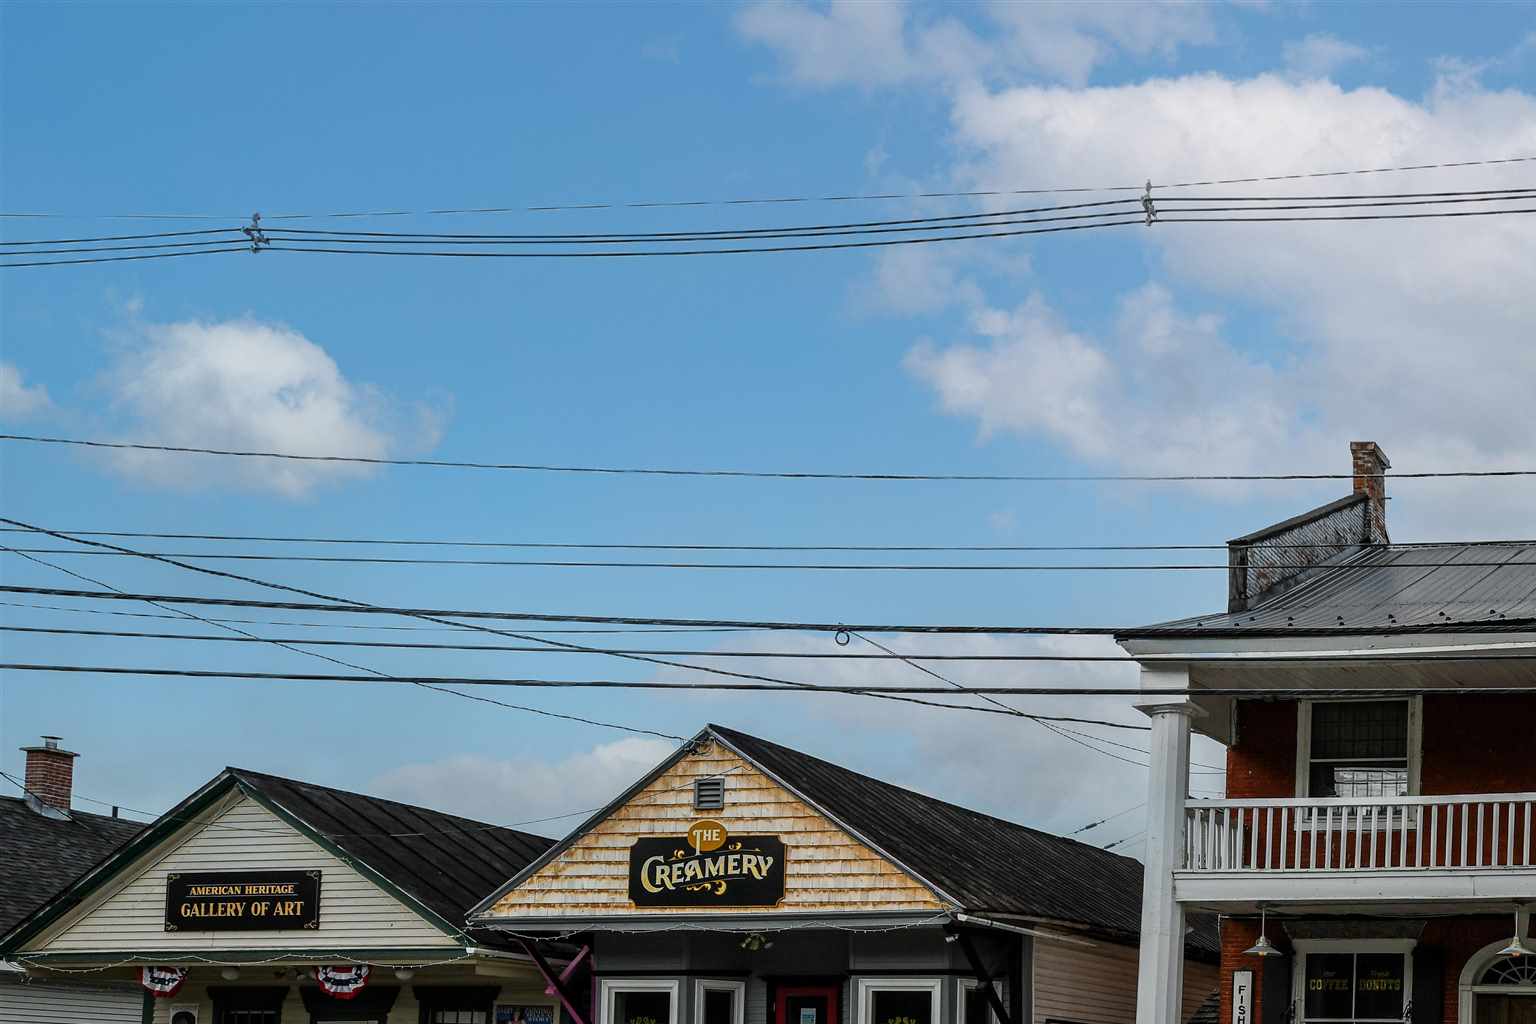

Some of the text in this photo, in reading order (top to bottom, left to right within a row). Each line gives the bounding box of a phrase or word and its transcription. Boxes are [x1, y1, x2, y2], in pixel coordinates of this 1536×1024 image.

[692, 828, 721, 857] THE
[640, 853, 774, 894] CREAMERY
[190, 884, 294, 896] AMERICAN HERITAGE
[180, 901, 304, 917] GALLERY OF ART
[1309, 978, 1349, 991] COFFEE
